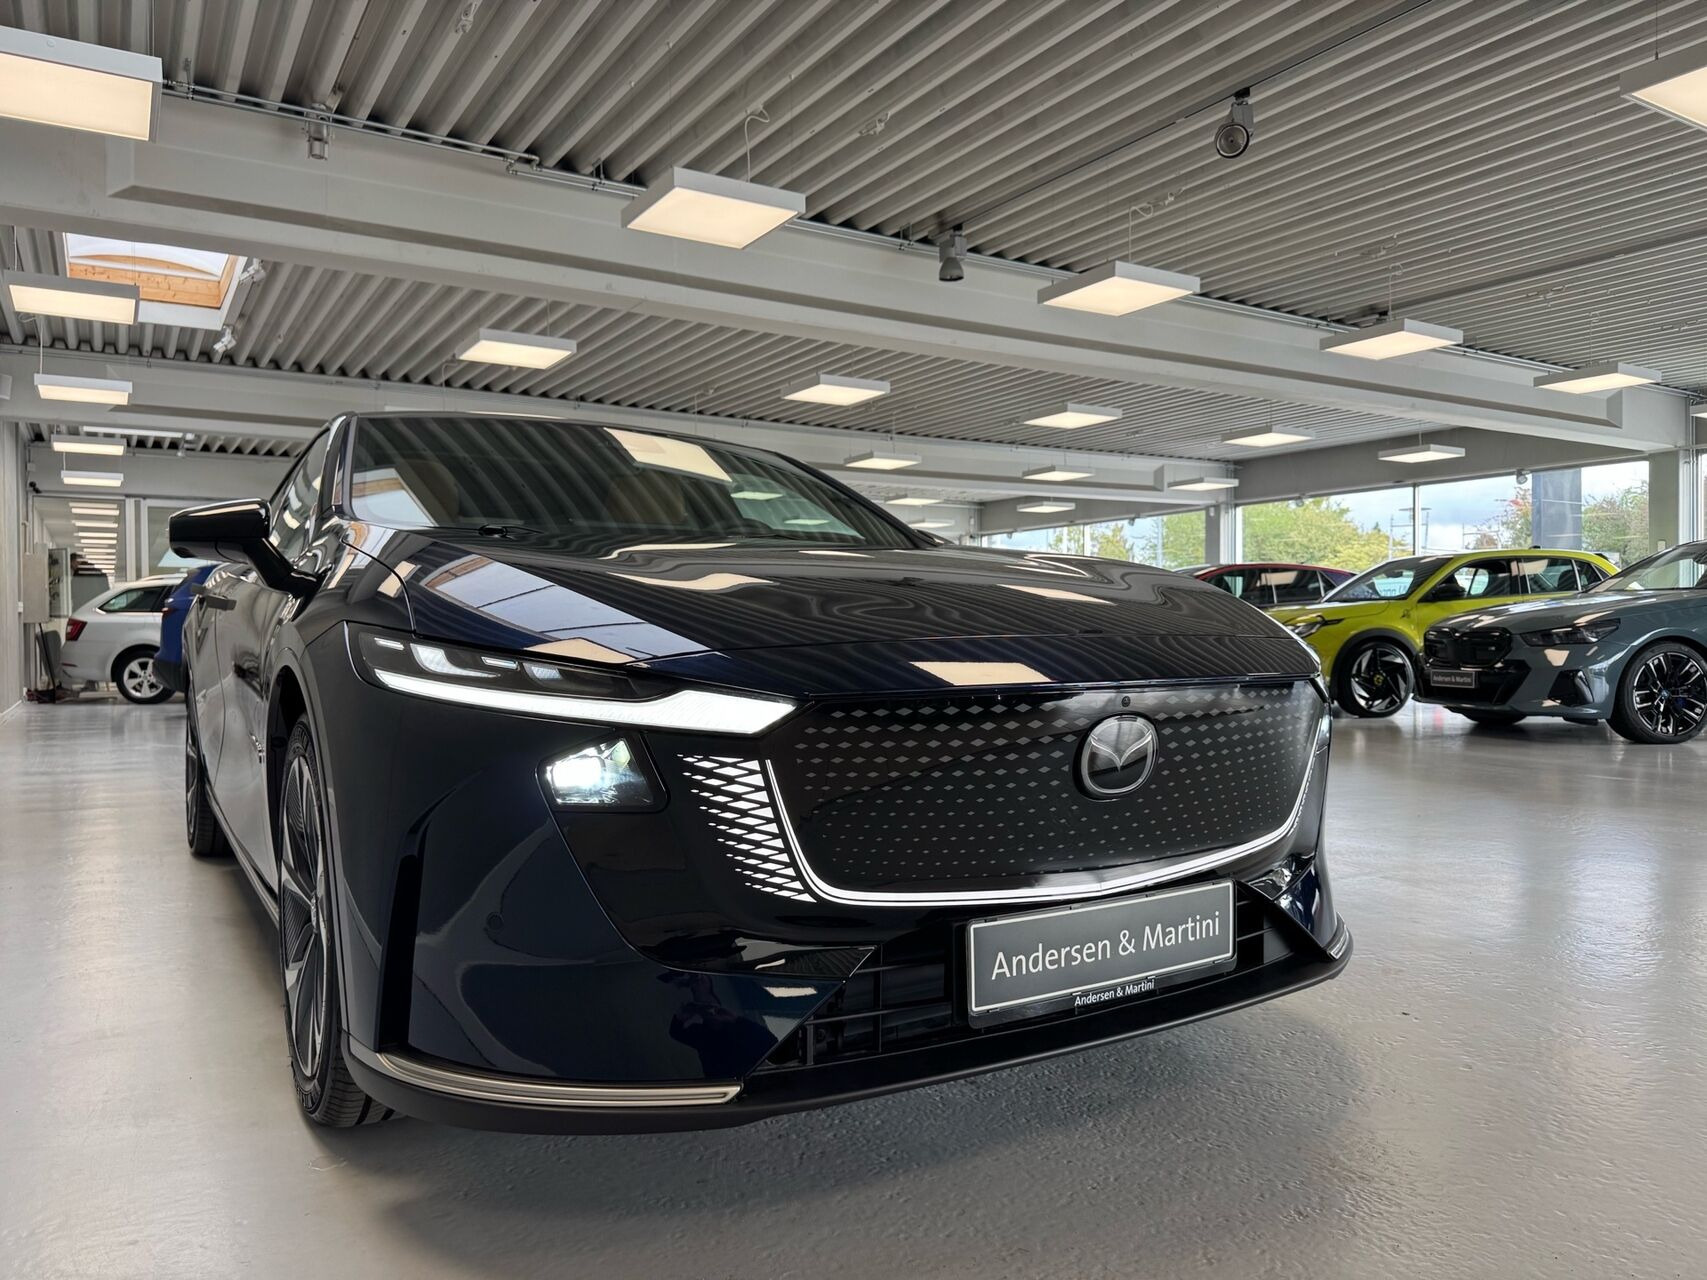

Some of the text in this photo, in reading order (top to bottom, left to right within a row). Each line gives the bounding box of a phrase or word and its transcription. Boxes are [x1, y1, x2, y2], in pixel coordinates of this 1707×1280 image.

[991, 911, 1220, 980] Andersen & Martini
[1074, 979, 1155, 1007] Andersen & Martini
